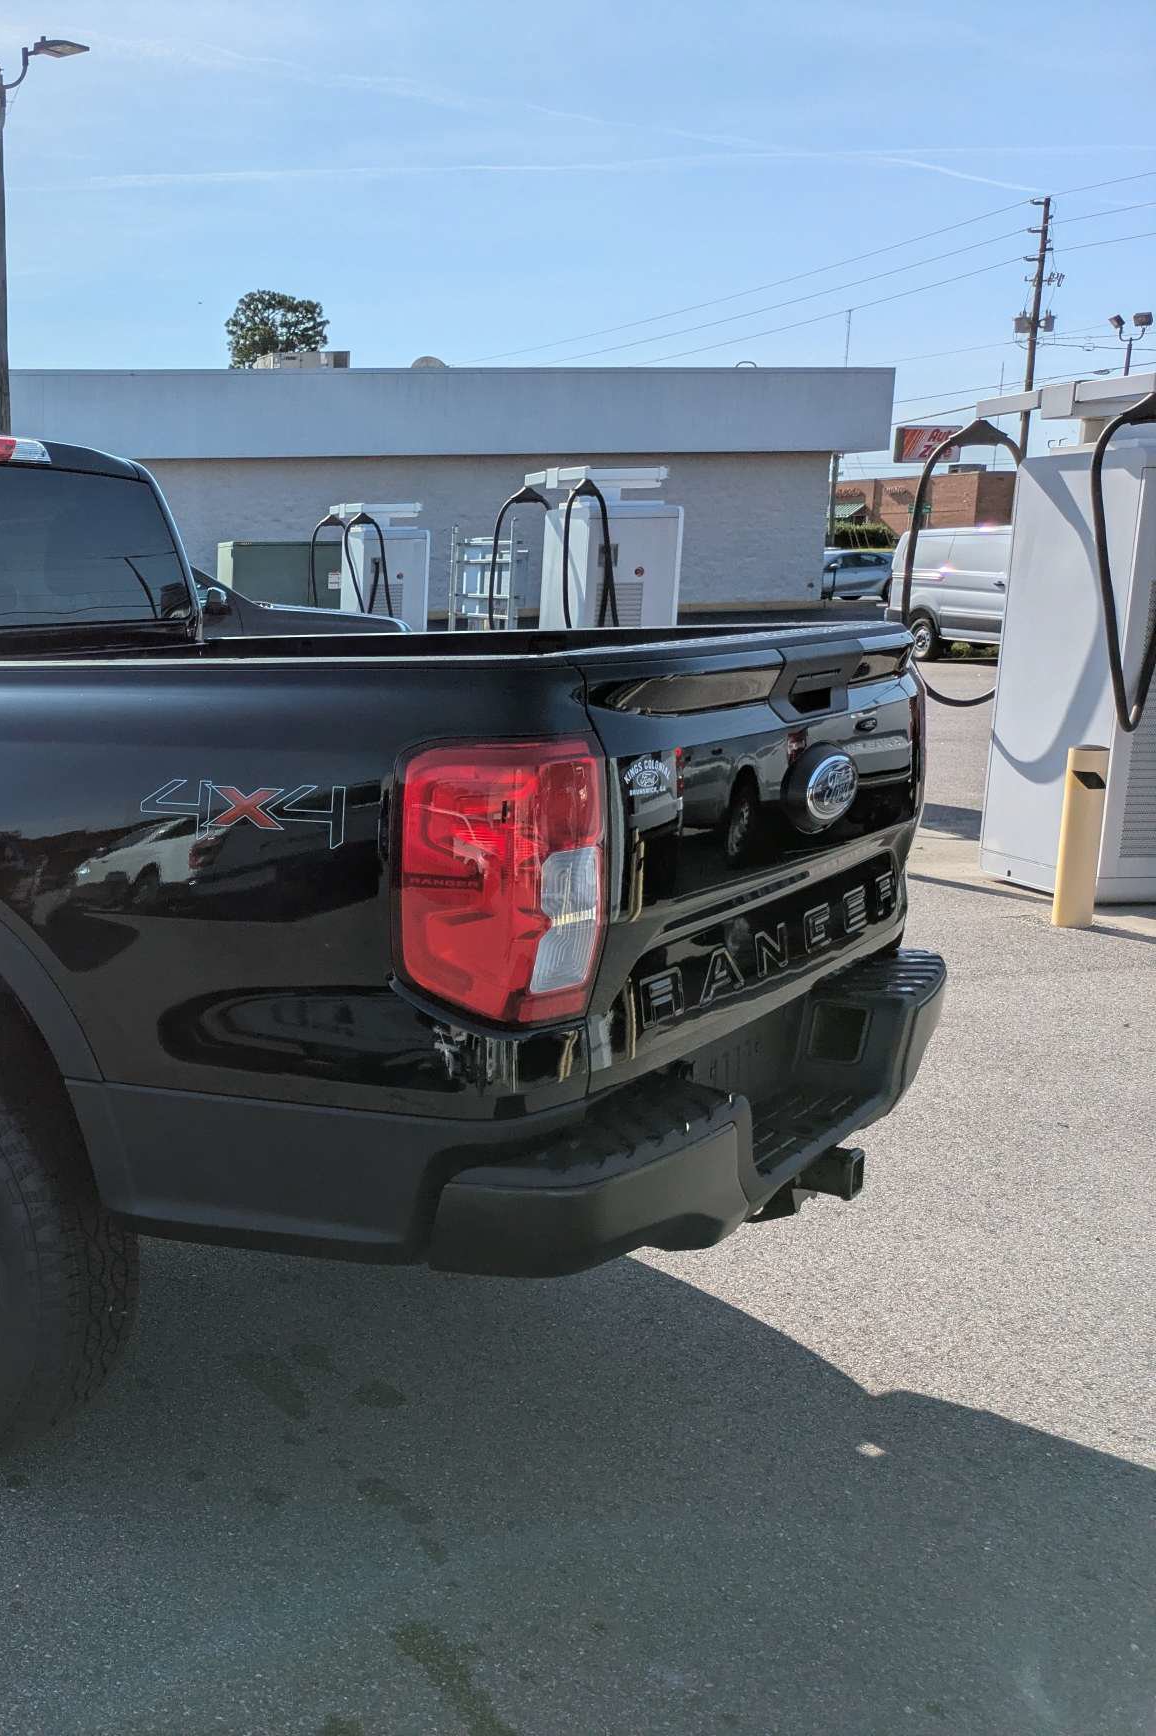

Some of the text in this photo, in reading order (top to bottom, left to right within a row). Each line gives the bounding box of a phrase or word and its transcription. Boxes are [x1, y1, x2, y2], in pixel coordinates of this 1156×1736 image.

[928, 428, 957, 442] Aut
[623, 761, 643, 785] KINGS
[823, 763, 855, 803] Ford
[409, 877, 479, 889] RANGER
[639, 870, 895, 1029] RANGER
